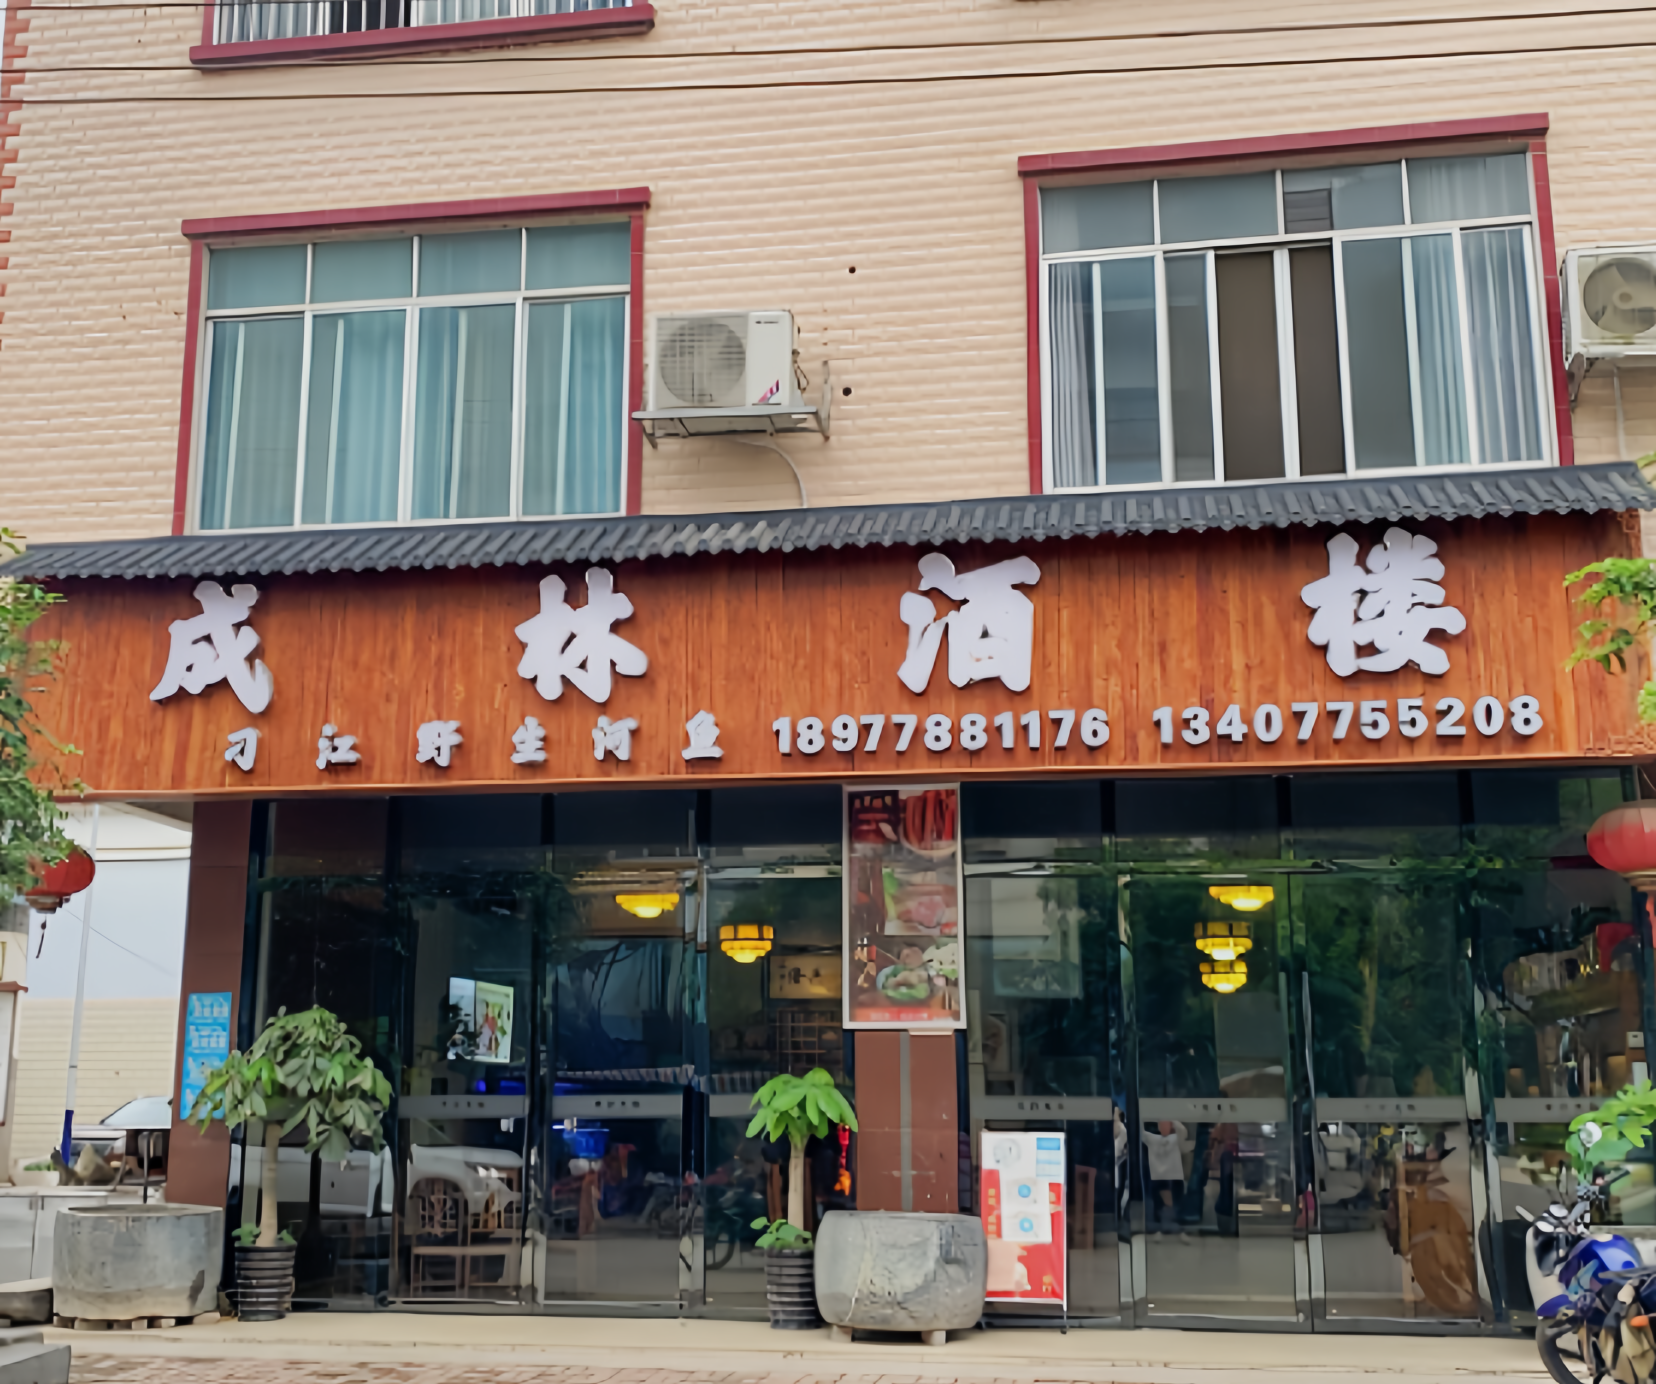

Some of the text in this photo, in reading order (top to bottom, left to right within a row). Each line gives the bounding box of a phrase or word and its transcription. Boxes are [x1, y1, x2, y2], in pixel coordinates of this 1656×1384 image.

[149, 526, 1467, 714] 成林酒楼
[772, 708, 1110, 754] 18977881176
[1152, 693, 1544, 744] 13407755208
